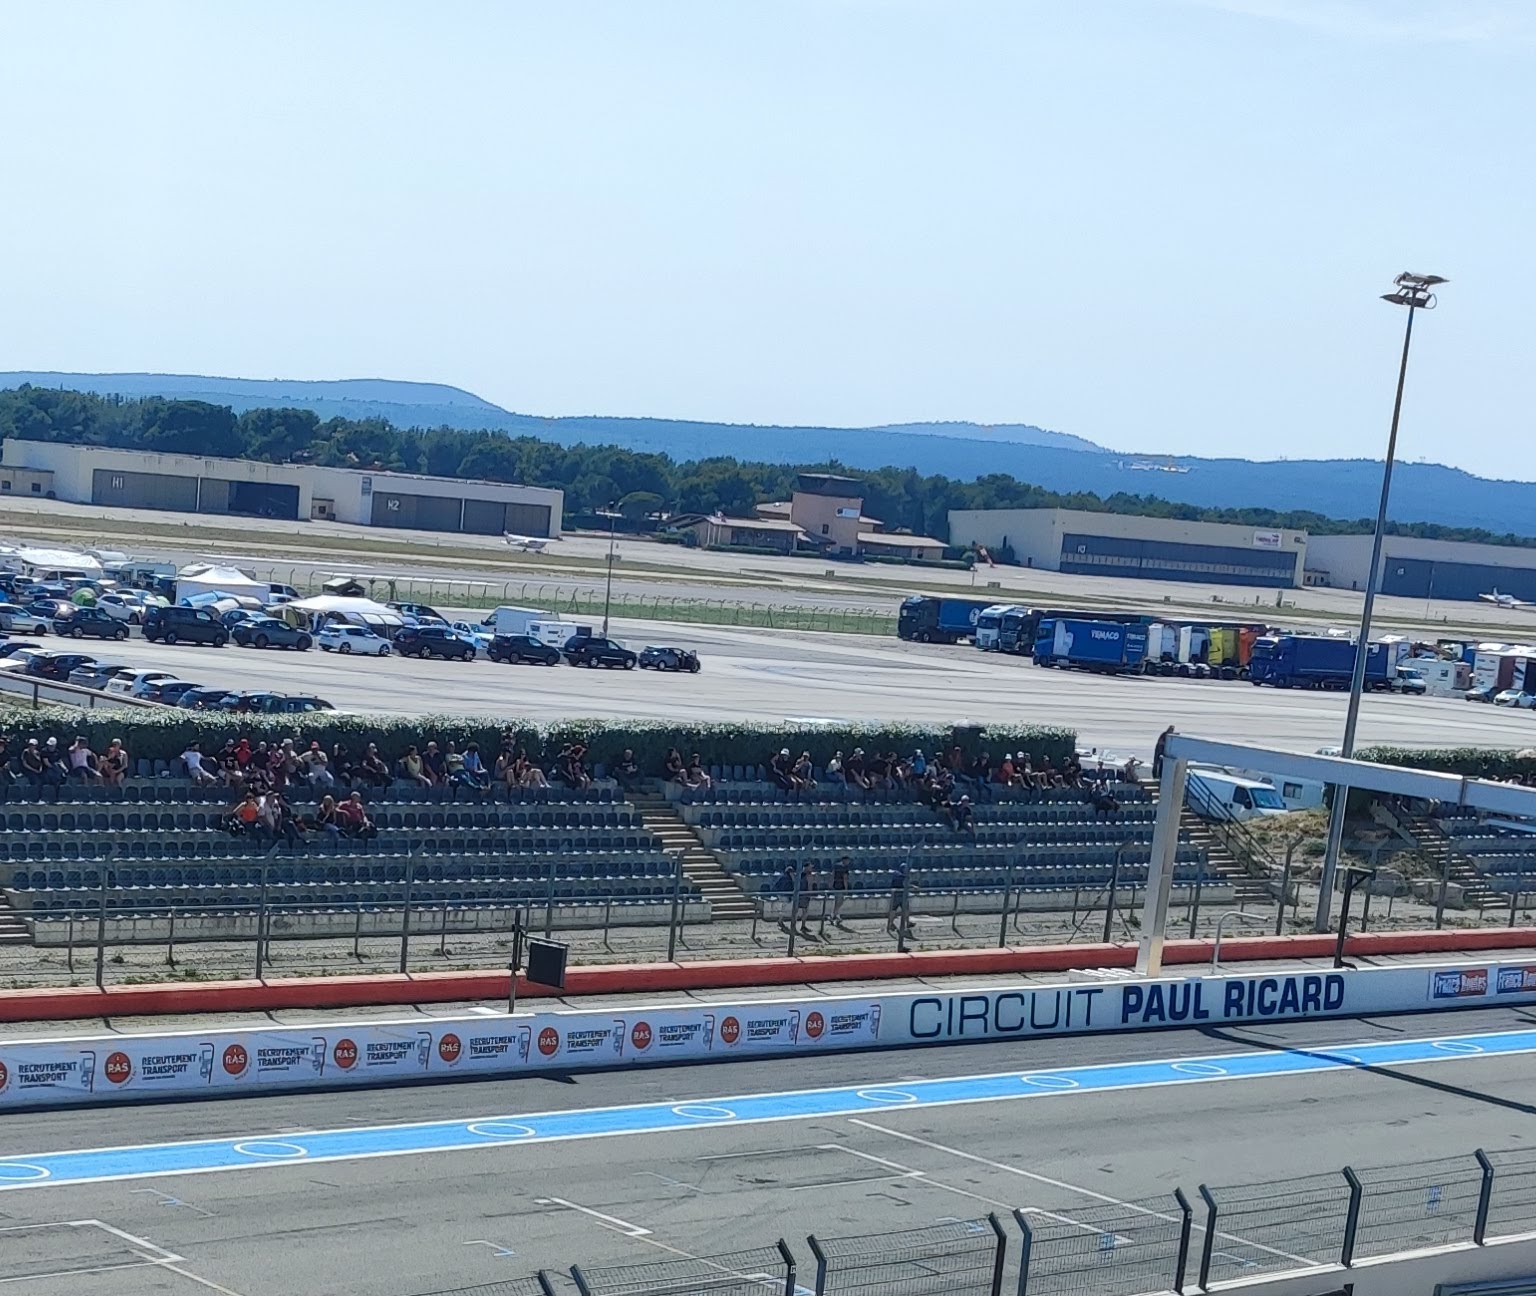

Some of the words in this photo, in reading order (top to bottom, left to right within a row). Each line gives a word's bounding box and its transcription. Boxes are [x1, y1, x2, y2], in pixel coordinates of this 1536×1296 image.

[910, 989, 1103, 1038] CIRCUIT
[1121, 982, 1209, 1024] PAUL
[1224, 974, 1345, 1018] RICARD
